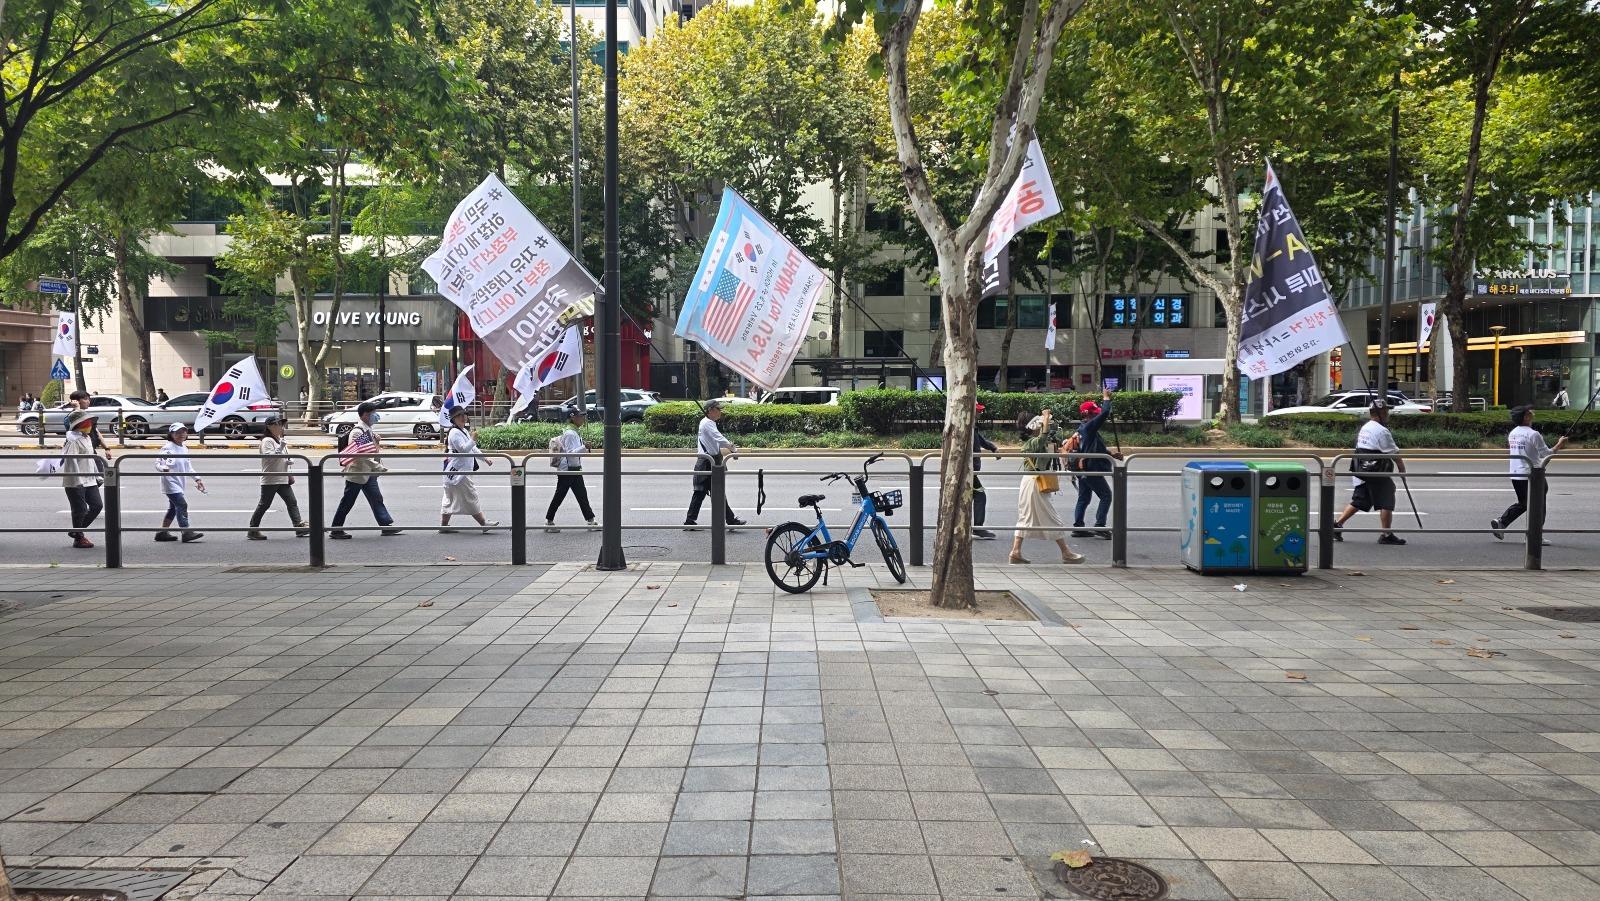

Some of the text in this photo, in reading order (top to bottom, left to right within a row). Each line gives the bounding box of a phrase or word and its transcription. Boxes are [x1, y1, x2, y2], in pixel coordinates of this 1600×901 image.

[1489, 284, 1518, 295] 해우리
[1154, 298, 1182, 311] 신경
[364, 311, 421, 325] YOUNG
[1154, 312, 1182, 324] 외과
